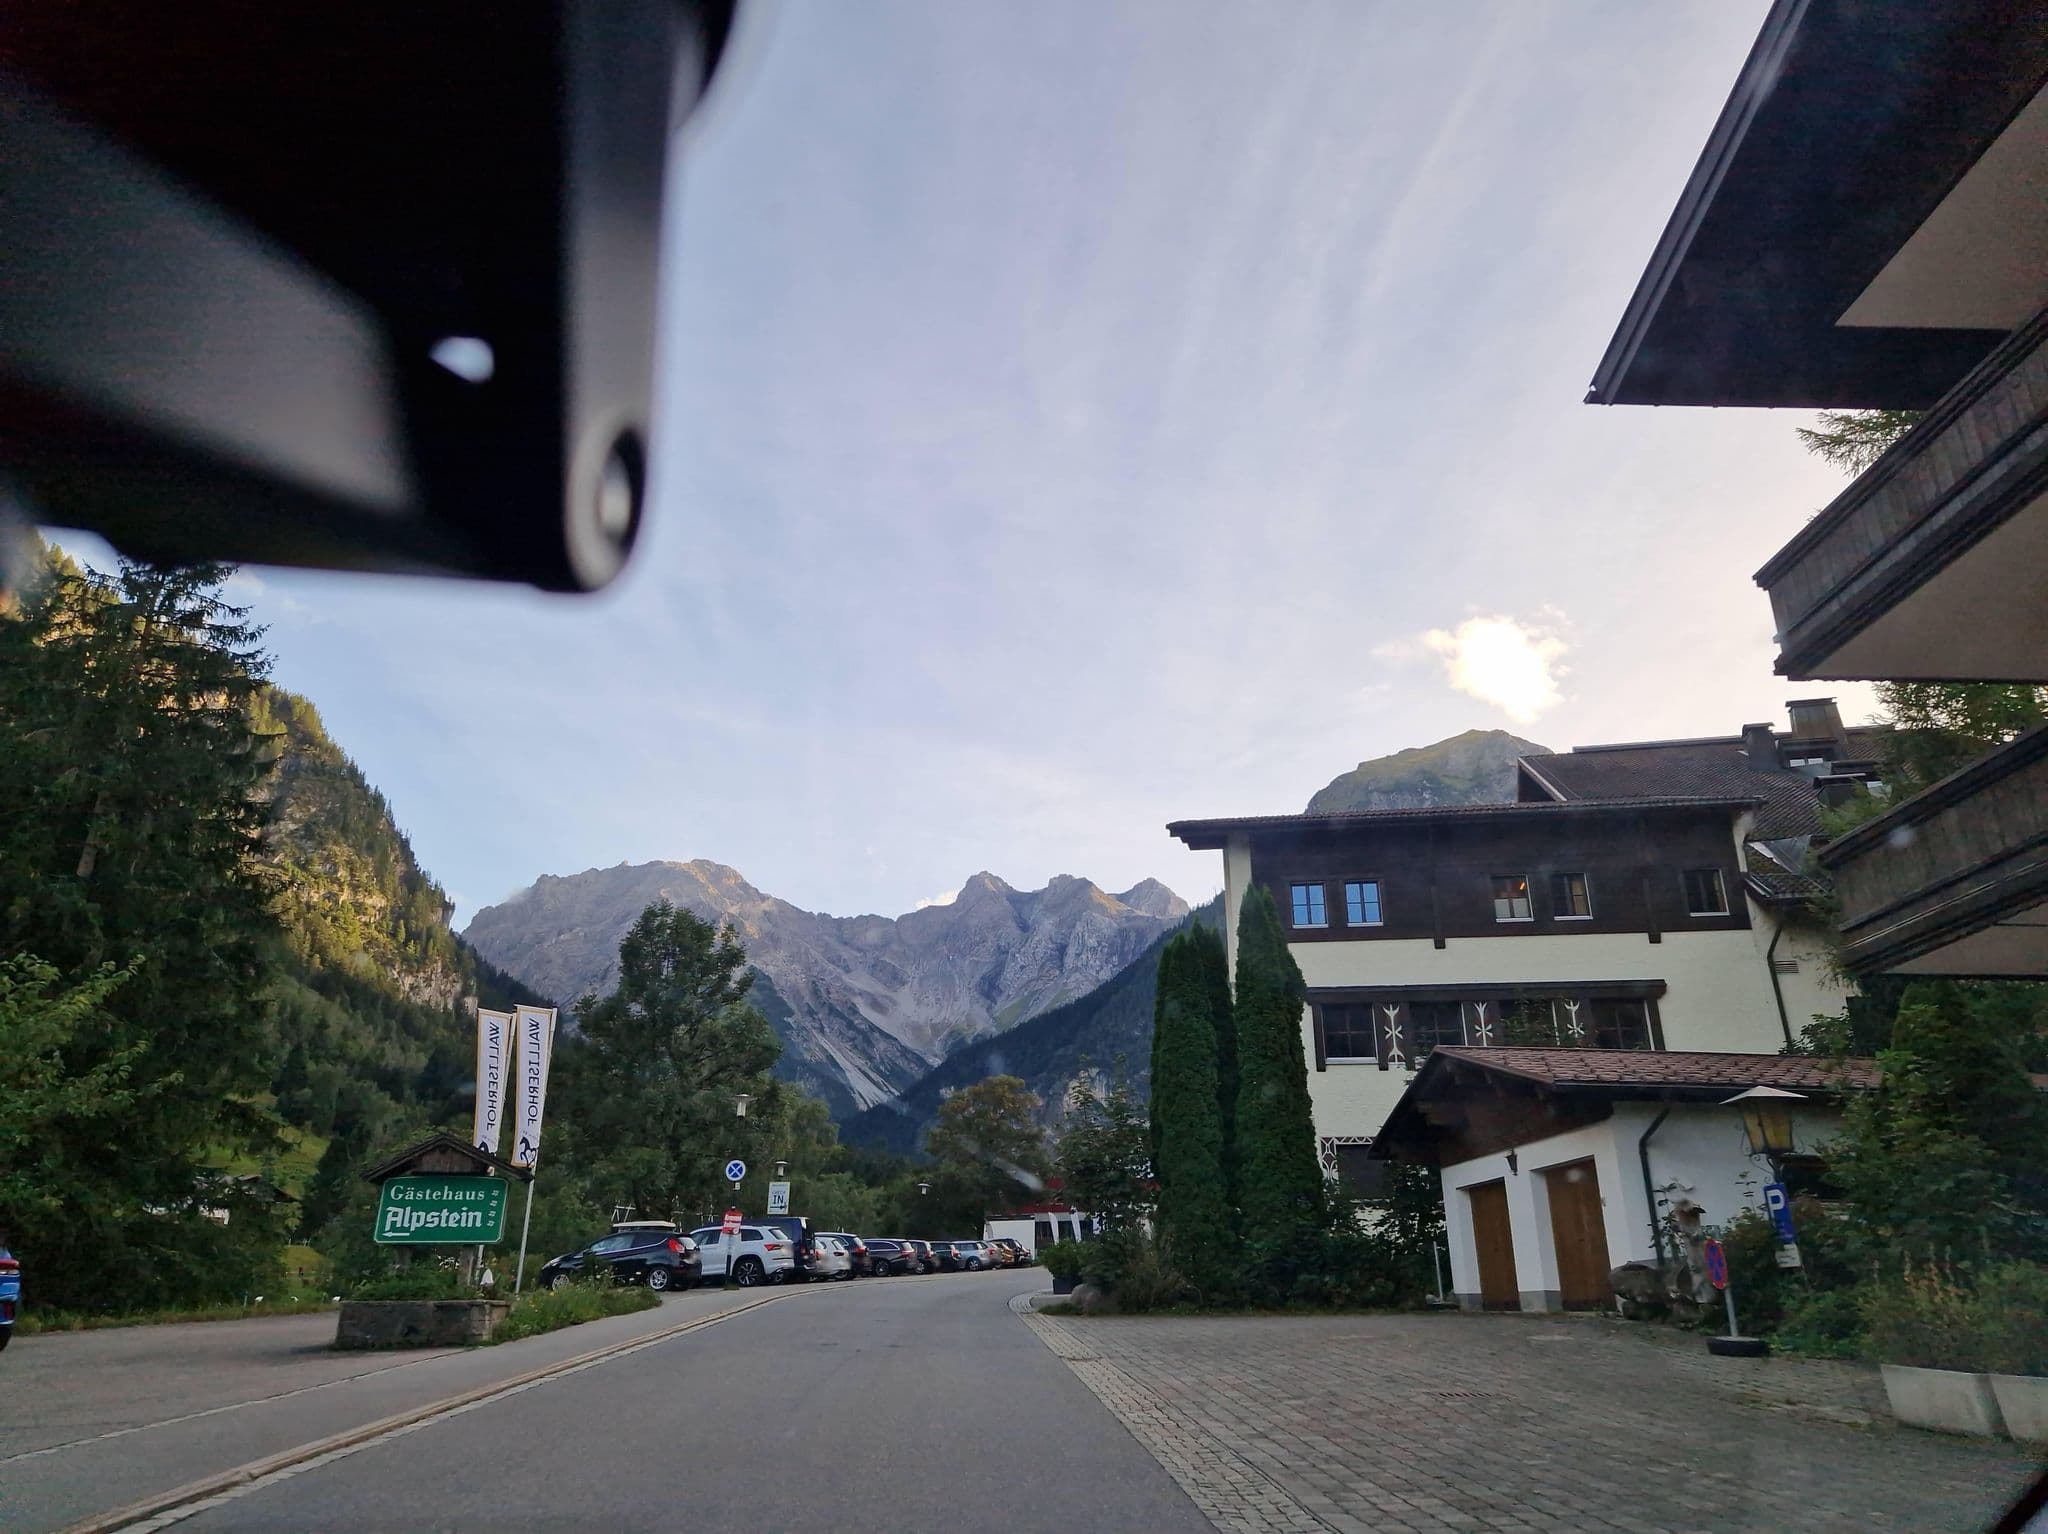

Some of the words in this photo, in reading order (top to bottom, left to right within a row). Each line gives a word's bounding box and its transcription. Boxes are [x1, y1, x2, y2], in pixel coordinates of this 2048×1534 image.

[390, 1185, 485, 1201] Gästehaus
[773, 1195, 784, 1205] IN
[1766, 1189, 1785, 1219] P
[385, 1206, 483, 1232] Alpstein
